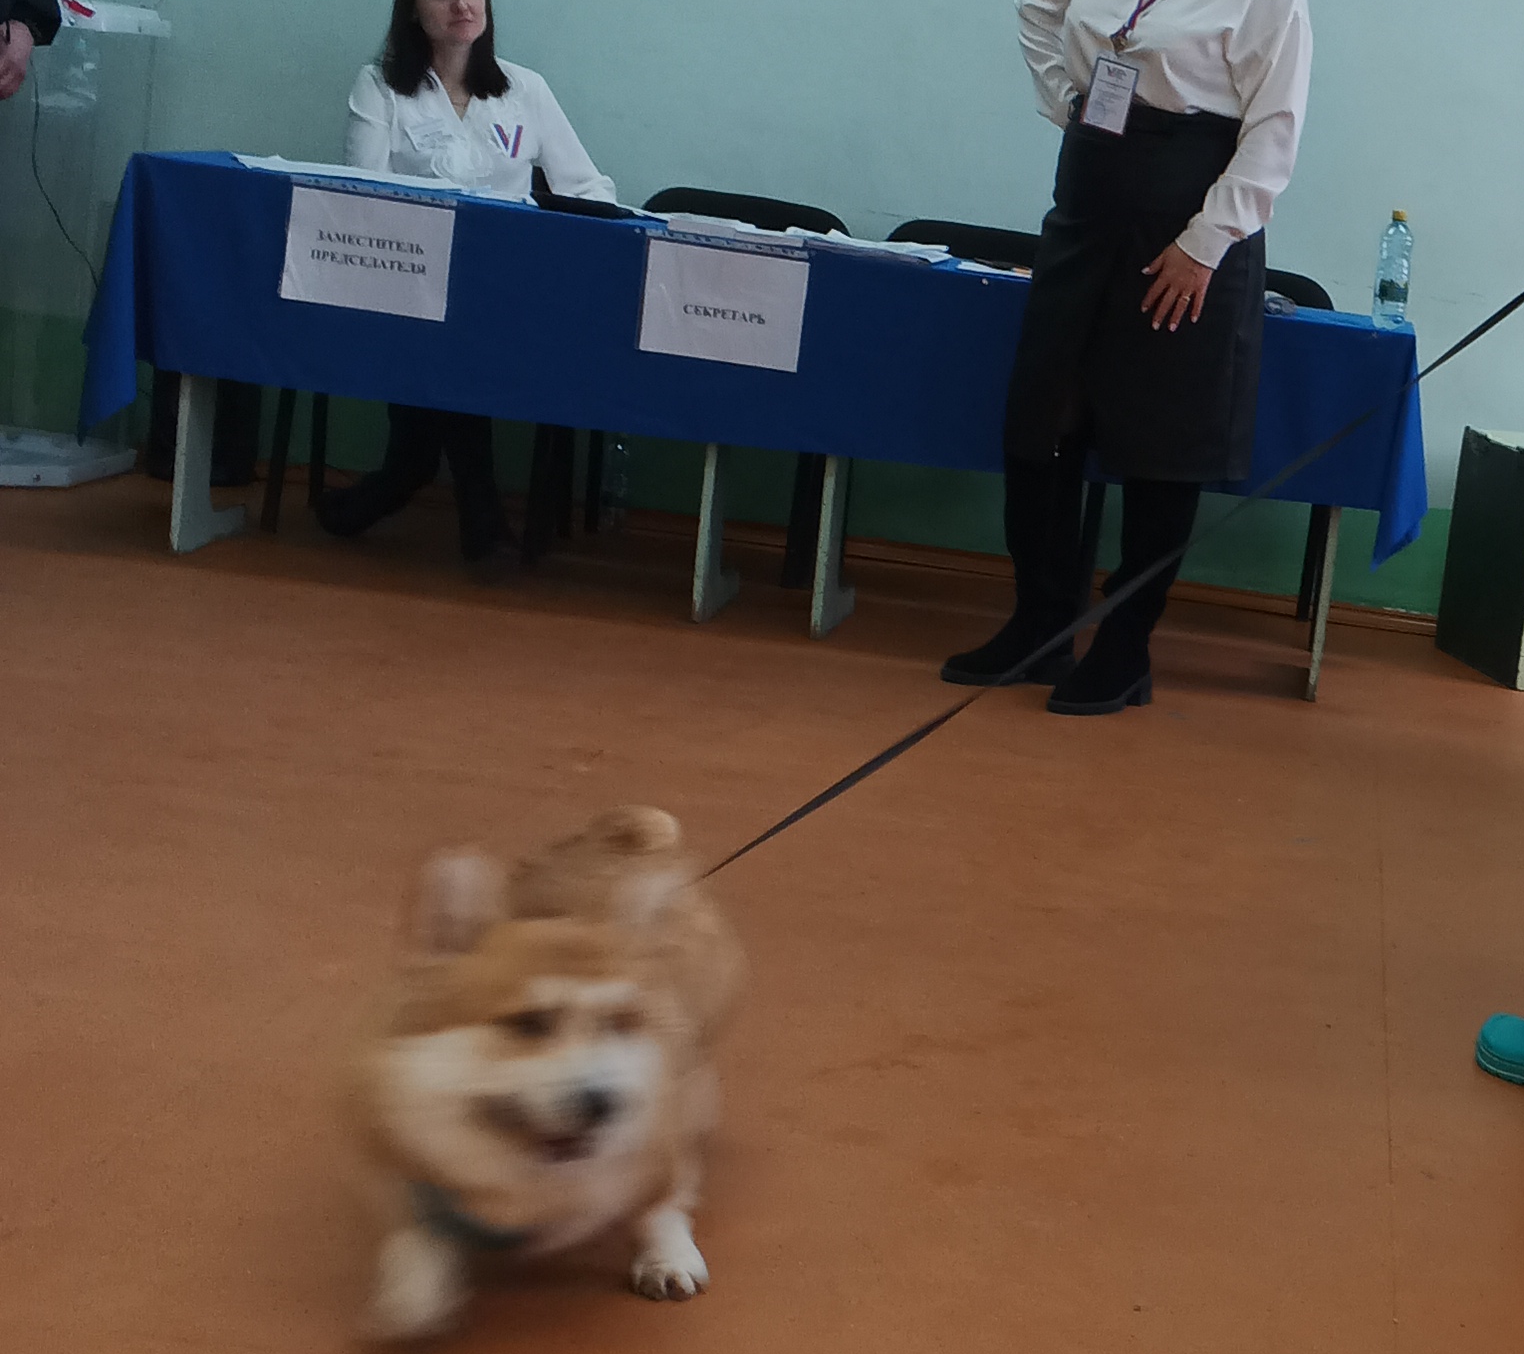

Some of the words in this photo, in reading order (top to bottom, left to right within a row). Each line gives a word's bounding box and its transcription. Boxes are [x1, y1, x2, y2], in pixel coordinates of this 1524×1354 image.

[316, 228, 425, 256] ЗАМЕСТИТЕЛЬ
[309, 247, 427, 276] ПРЕДСЕДАТЕЛЯ
[682, 303, 766, 325] СЕКРЕТАРЬ
